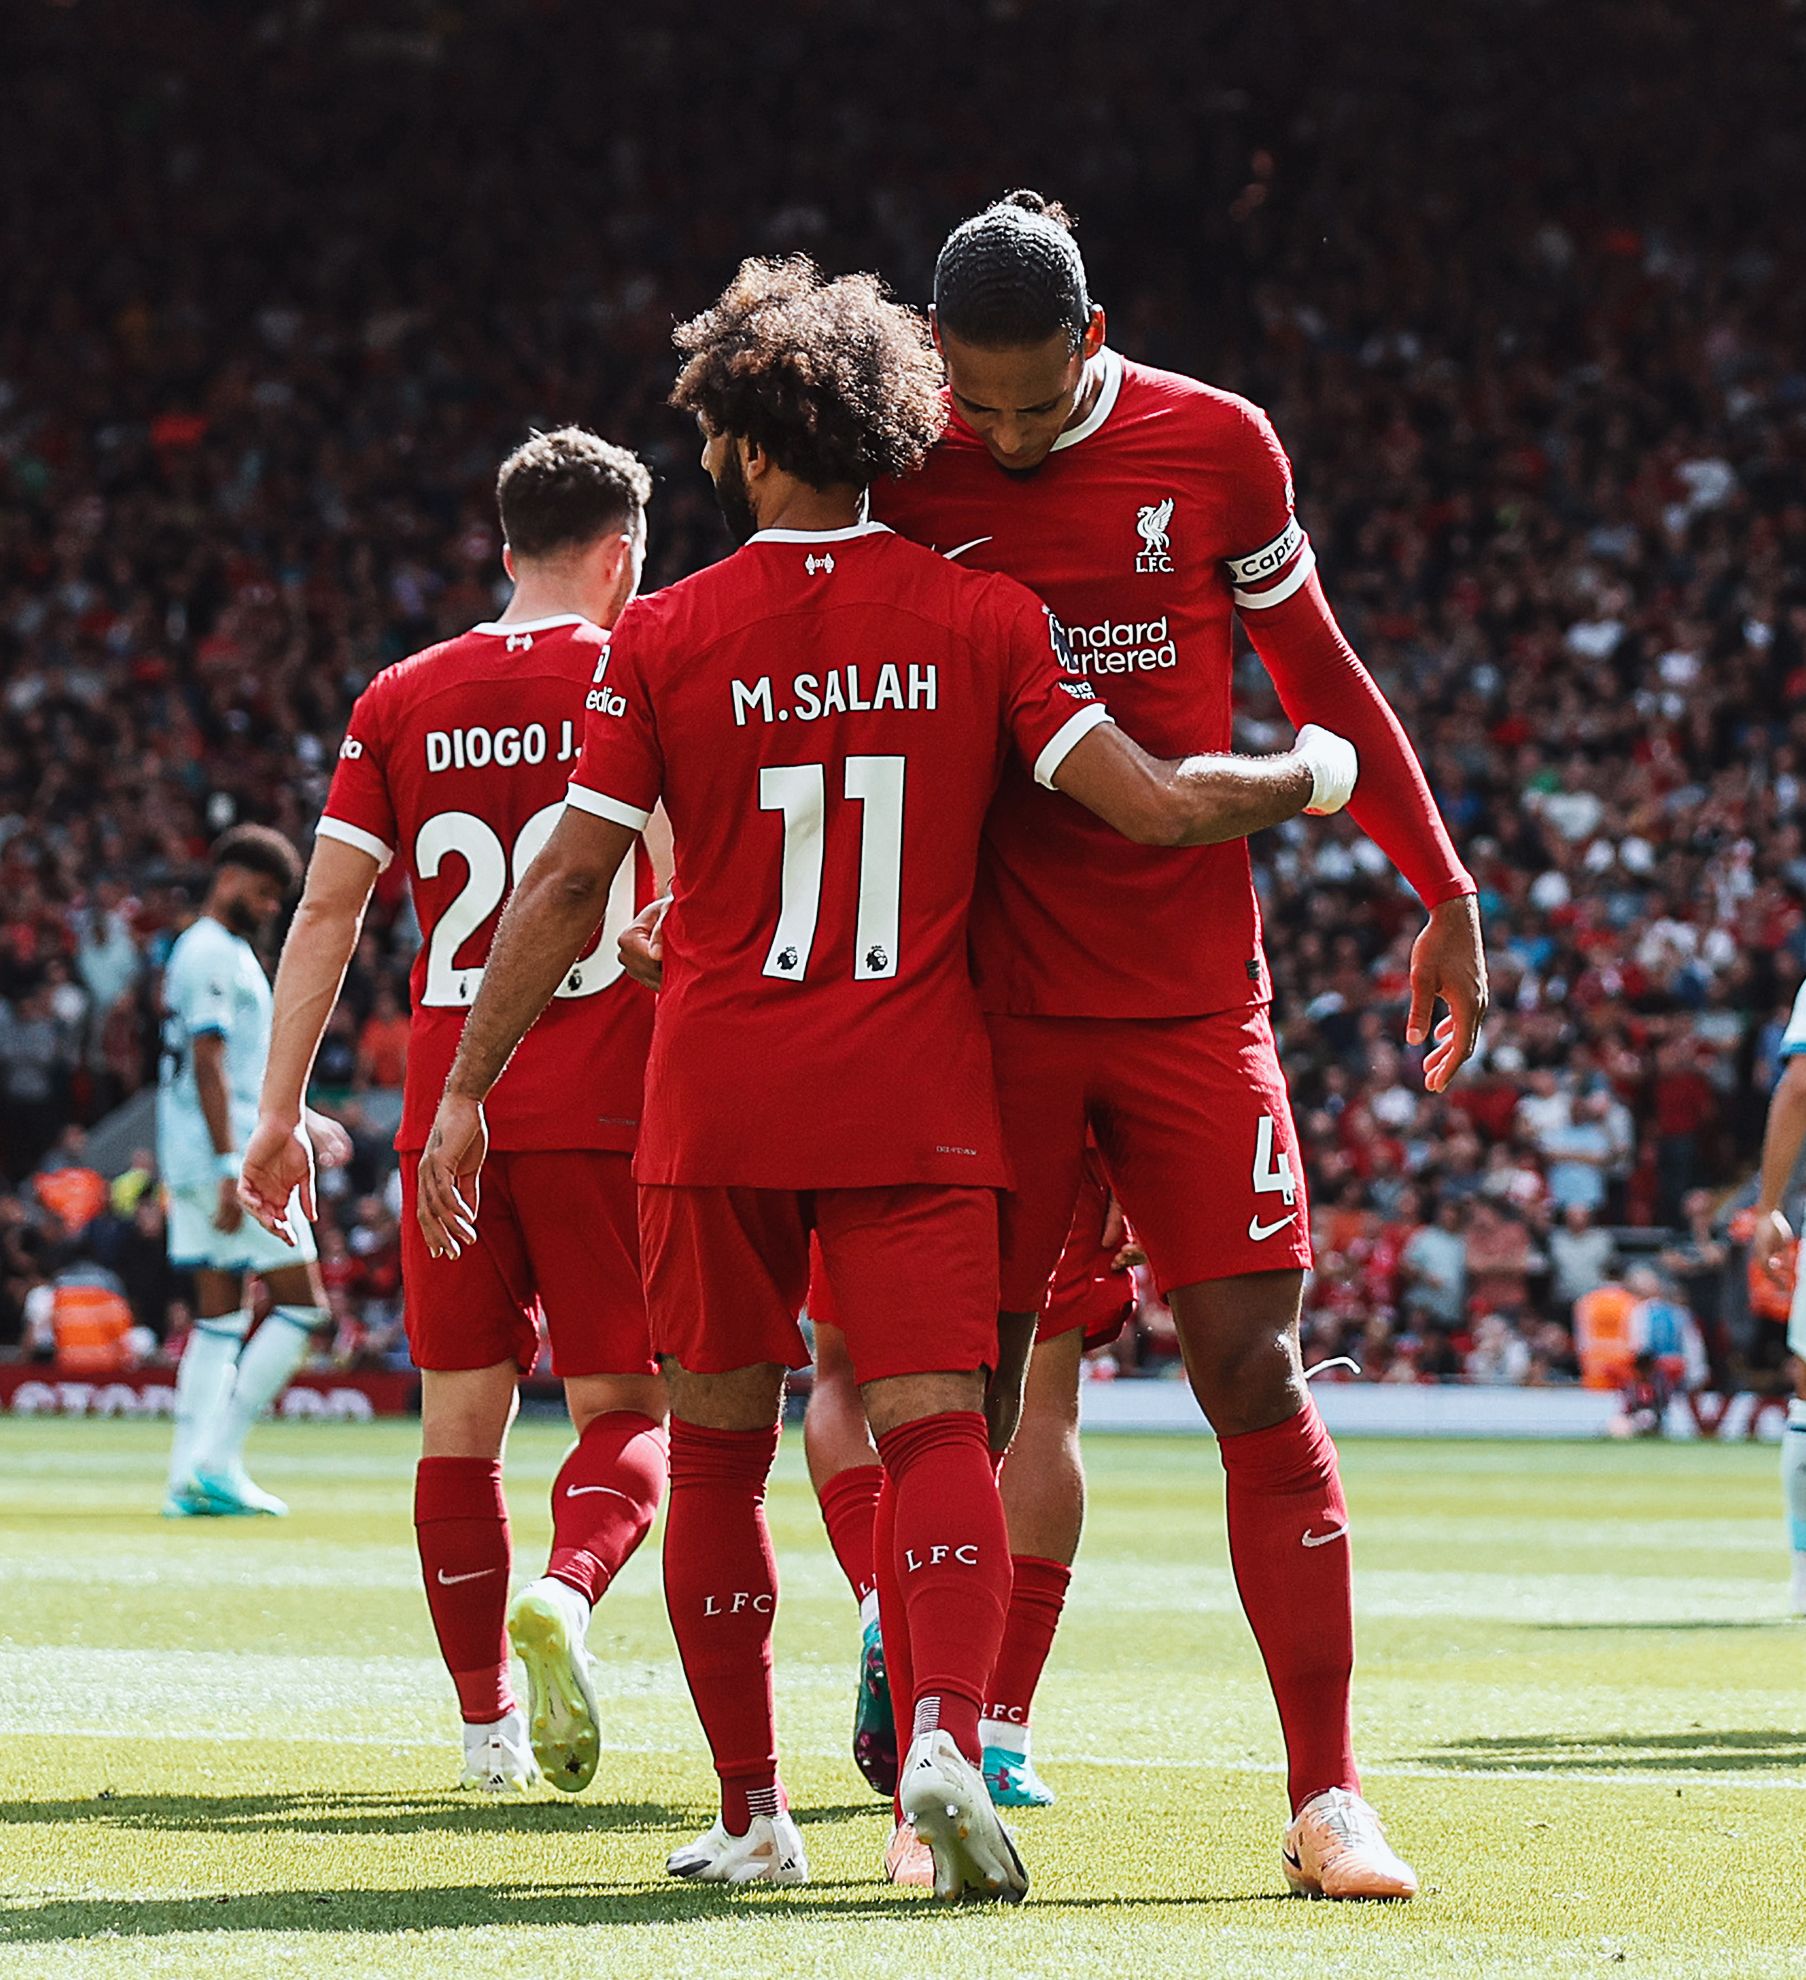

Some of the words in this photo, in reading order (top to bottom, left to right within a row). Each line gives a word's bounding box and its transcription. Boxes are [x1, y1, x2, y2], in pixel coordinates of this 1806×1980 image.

[731, 663, 938, 726] M.SALAH
[426, 723, 547, 773] DIOGO
[557, 720, 583, 762] J.
[759, 755, 906, 982] 11
[1252, 1115, 1297, 1206] 4
[905, 1544, 979, 1573] LFC
[703, 1592, 773, 1617] LFC
[980, 1702, 1024, 1722] LFC
